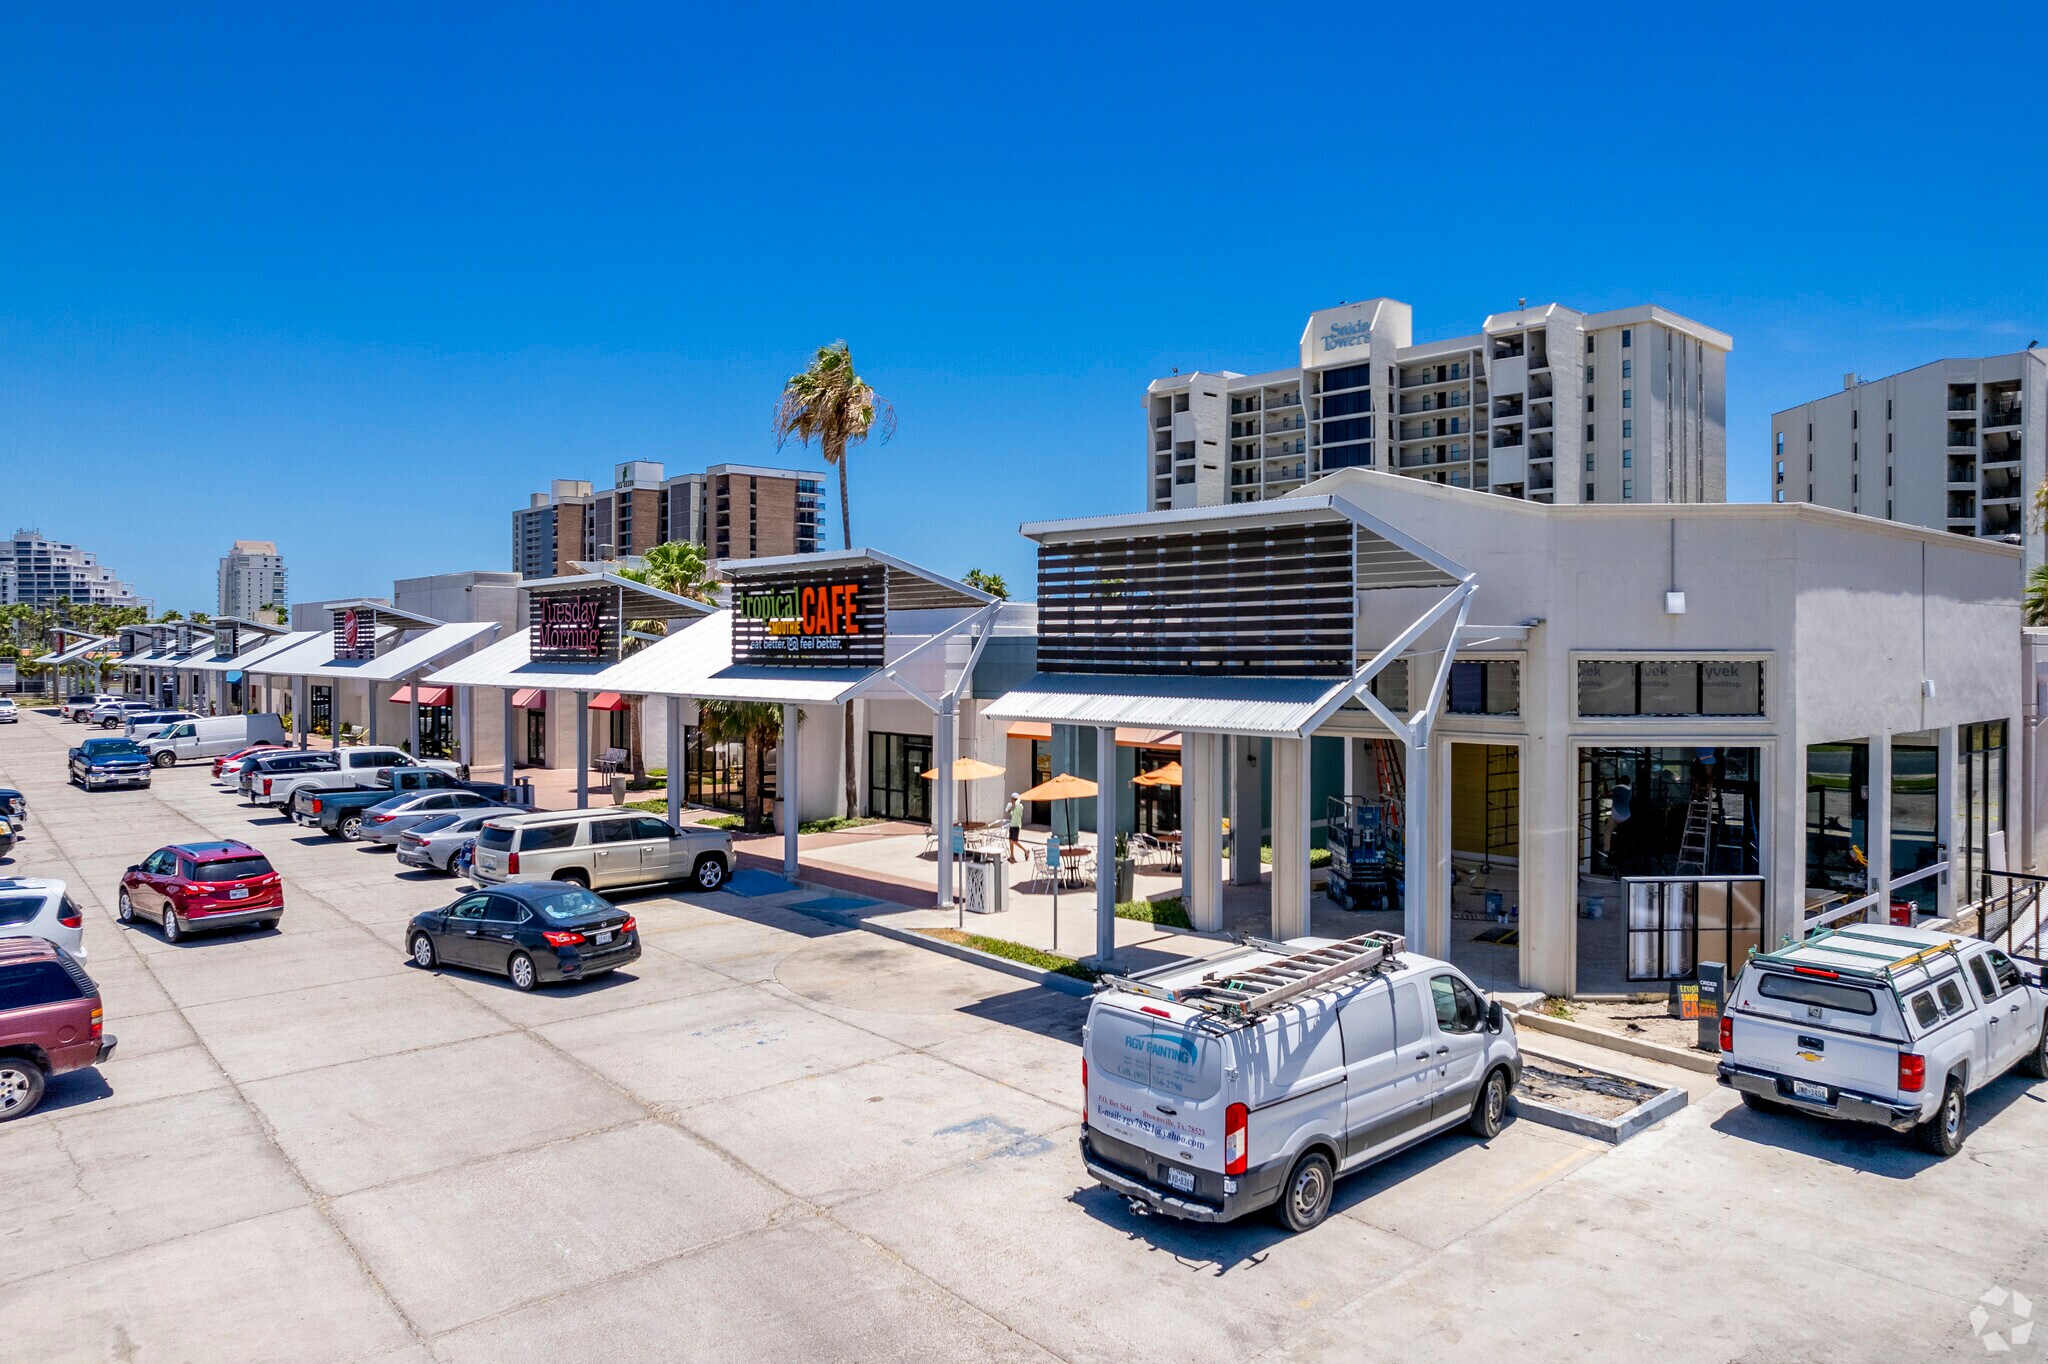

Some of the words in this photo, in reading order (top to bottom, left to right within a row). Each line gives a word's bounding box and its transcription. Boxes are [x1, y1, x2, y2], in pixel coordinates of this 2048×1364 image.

[1320, 332, 1371, 352] Towers
[540, 595, 600, 629] Tuesday
[740, 586, 801, 626] tropical
[801, 583, 859, 635] CAFE
[539, 621, 601, 656] Morning
[768, 620, 801, 635] SMOOTHIE
[750, 639, 762, 650] eat
[763, 639, 787, 650] better.
[800, 638, 815, 650] feel
[816, 638, 843, 650] better.
[1699, 979, 1718, 988] ORDER
[1701, 985, 1716, 993] HERE
[1125, 1036, 1145, 1051] RGV
[1146, 1042, 1189, 1064] PAINTING
[1097, 1104, 1122, 1121] E-mail:
[1122, 1116, 1206, 1150] rgv78521@yahoo.com
